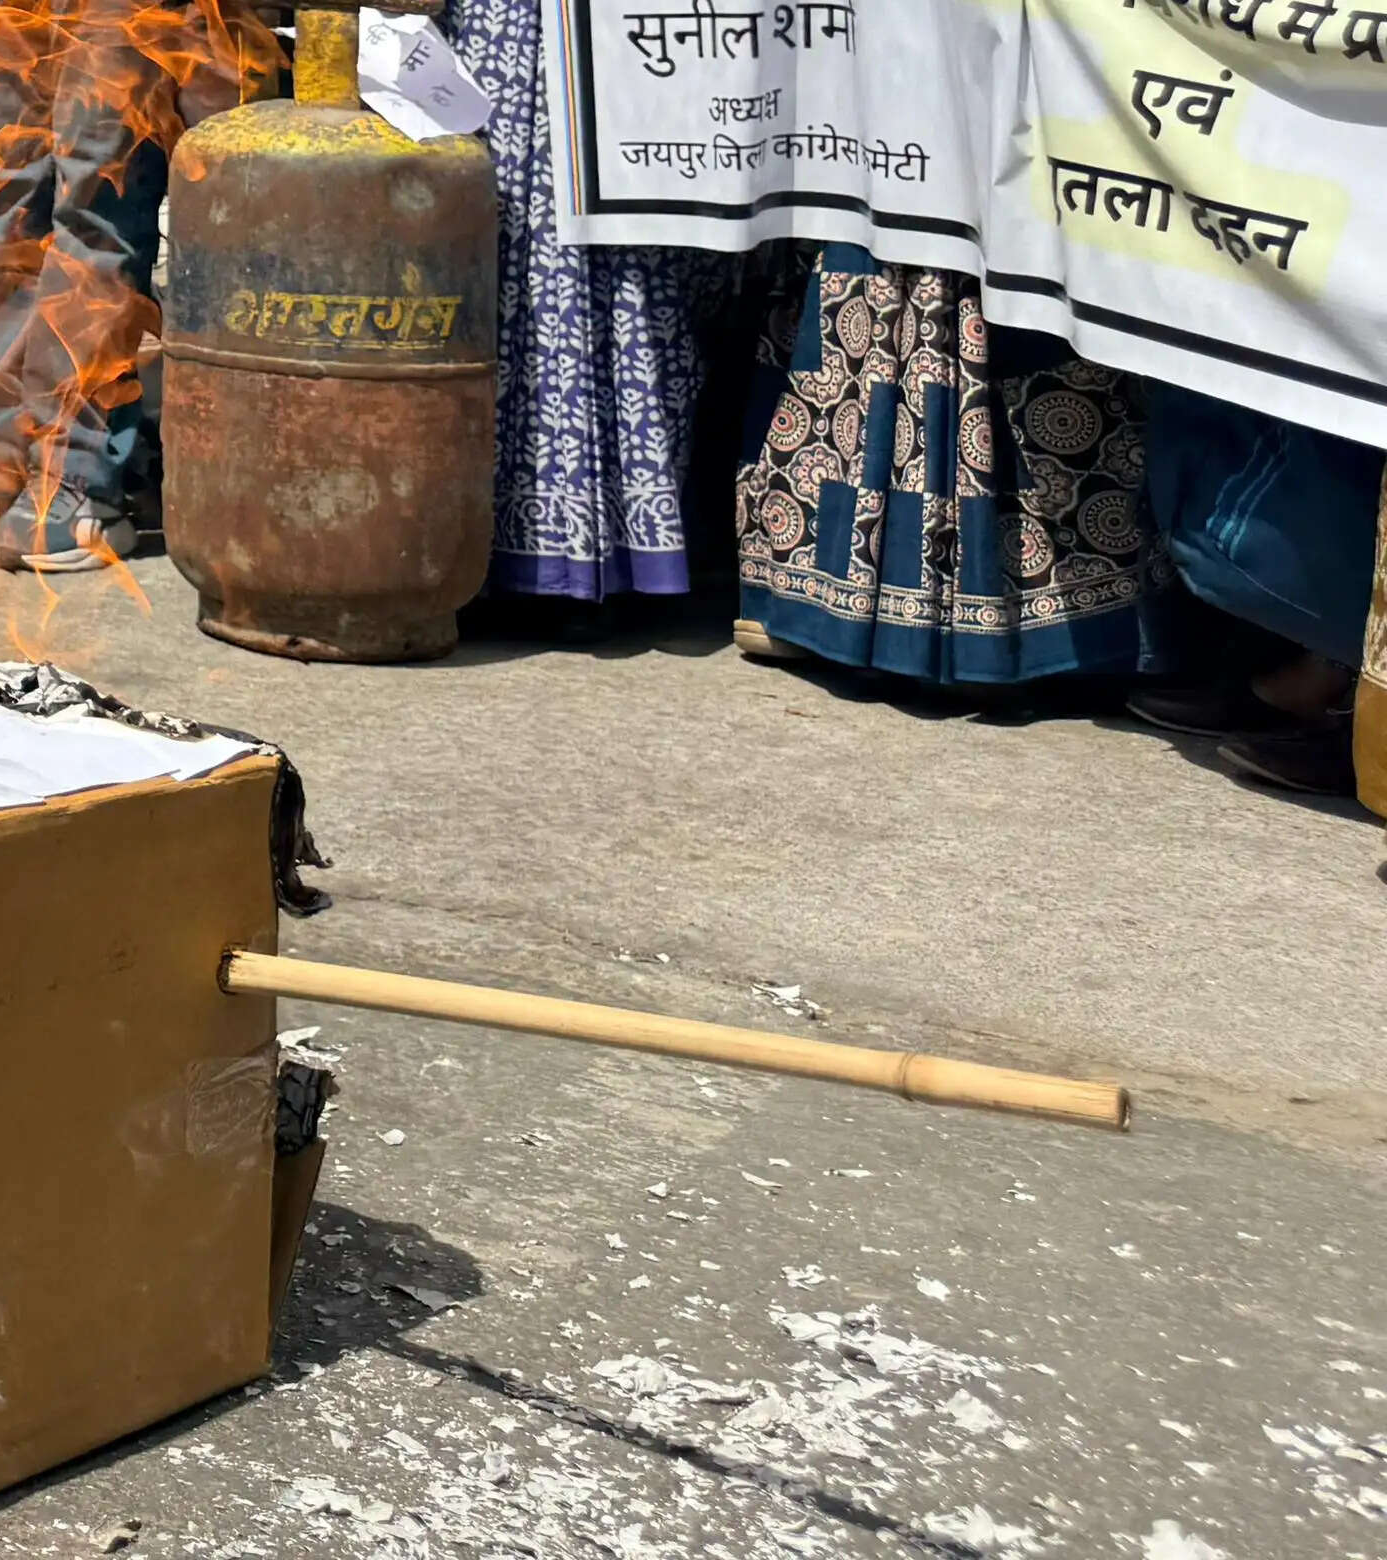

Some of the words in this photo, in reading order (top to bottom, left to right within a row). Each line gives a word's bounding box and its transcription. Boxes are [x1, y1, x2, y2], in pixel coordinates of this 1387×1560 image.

[1342, 9, 1387, 64] प्र
[709, 89, 783, 125] अध्यक्ष
[1132, 69, 1235, 140] एवं
[619, 141, 707, 179] जयपुर
[773, 123, 860, 163] कांग्रेस
[1183, 190, 1310, 271] दहन
